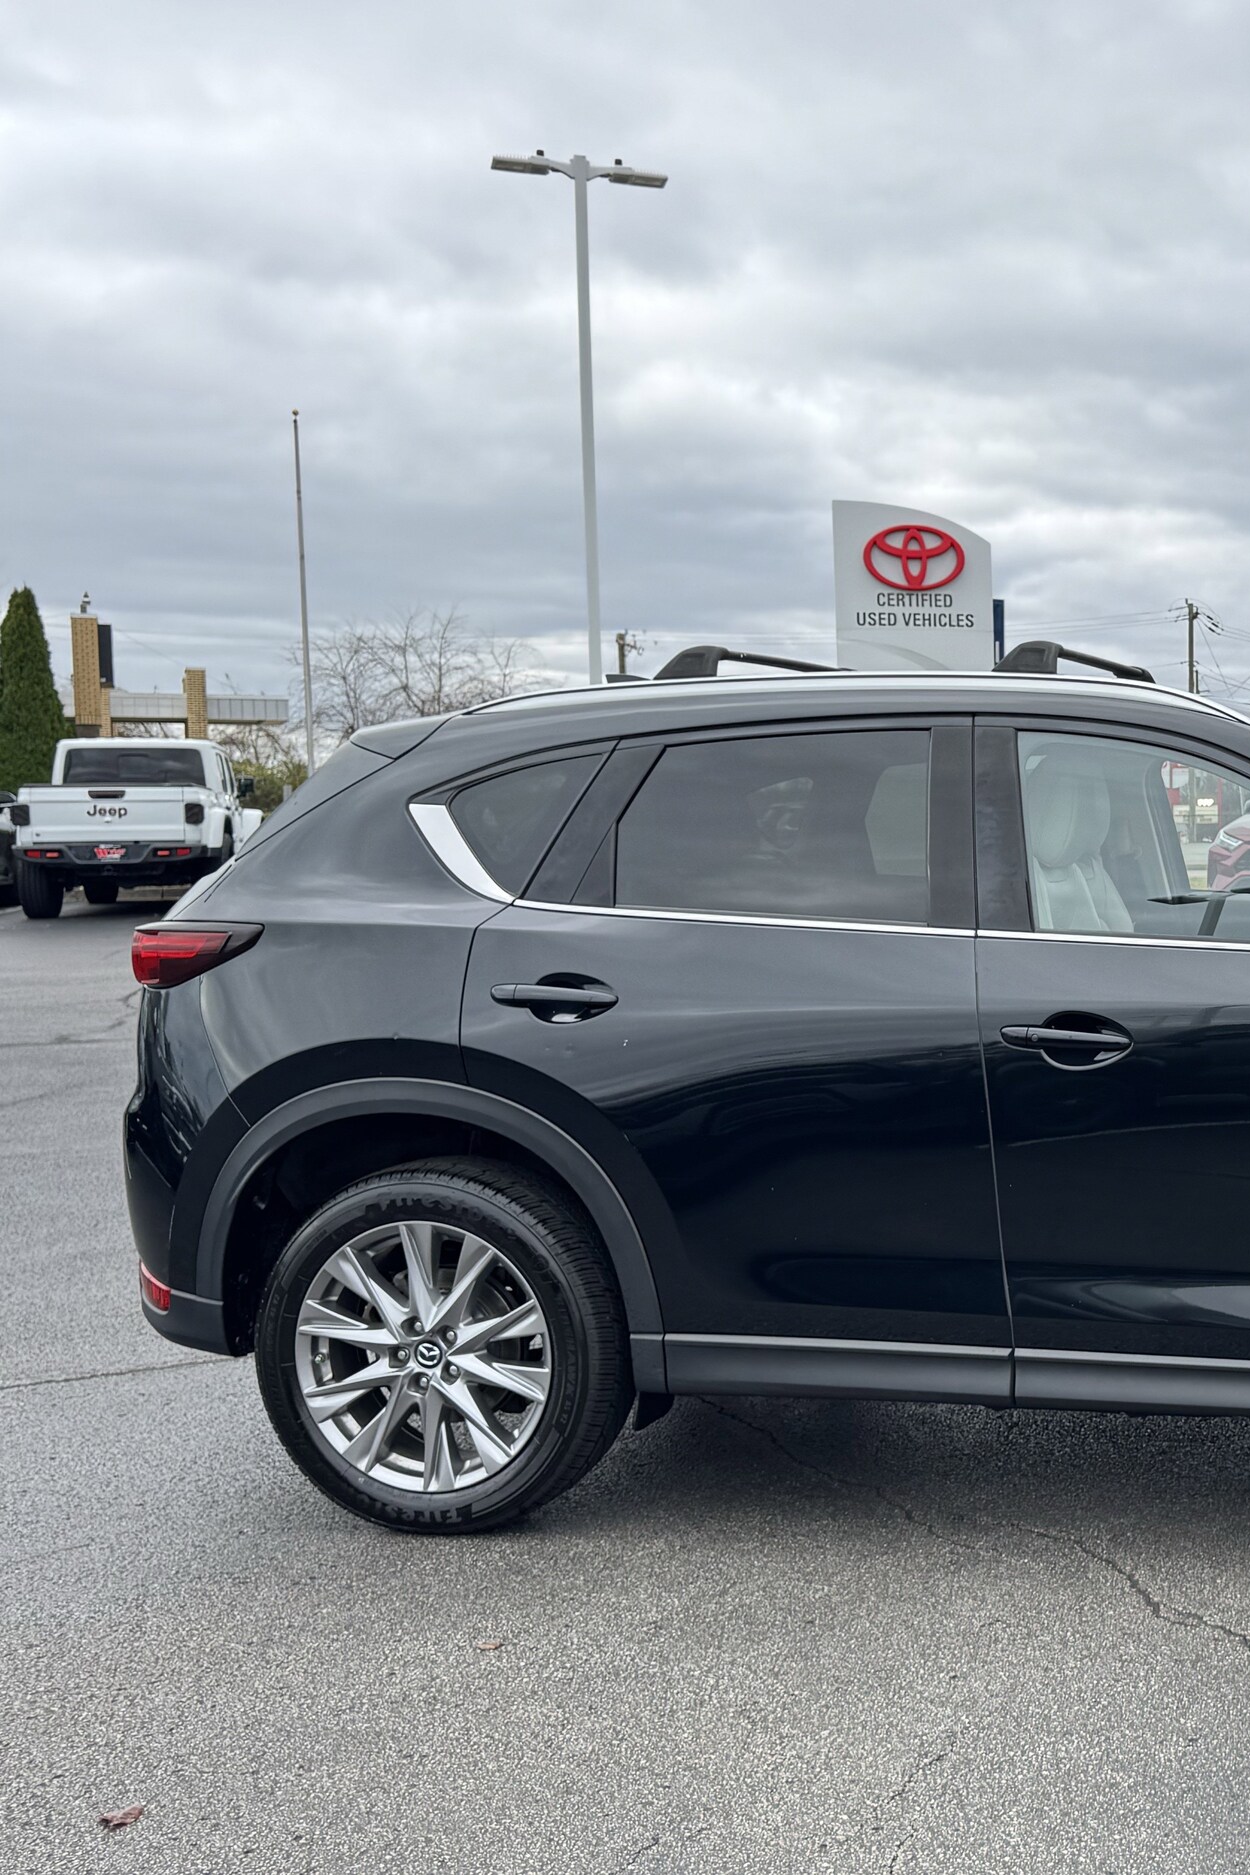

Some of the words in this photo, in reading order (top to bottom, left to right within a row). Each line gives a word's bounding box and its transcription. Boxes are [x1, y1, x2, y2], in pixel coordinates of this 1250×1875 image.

[876, 592, 953, 608] CERTIFIED
[856, 612, 897, 627] USED
[902, 612, 975, 628] VEHICLES
[86, 804, 128, 819] Jeep
